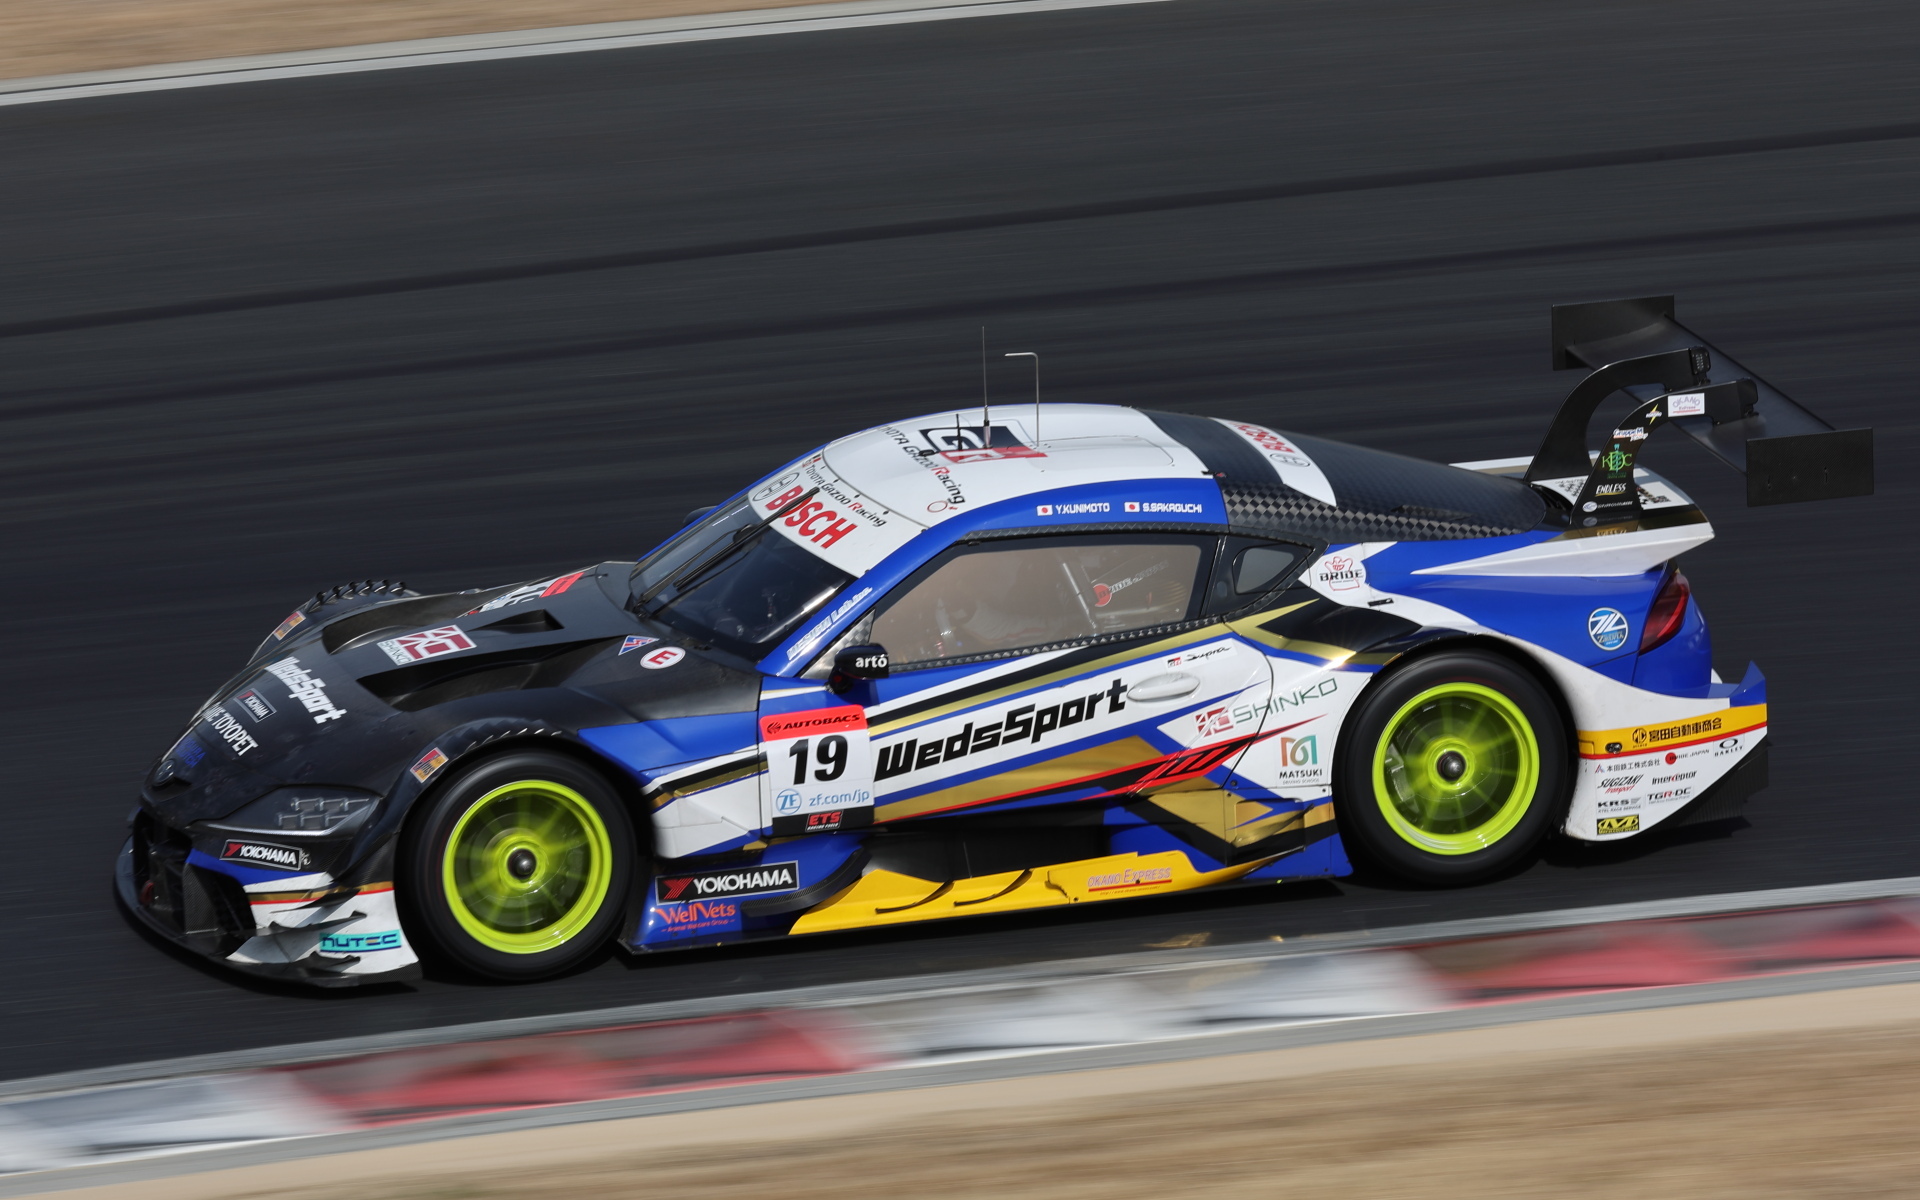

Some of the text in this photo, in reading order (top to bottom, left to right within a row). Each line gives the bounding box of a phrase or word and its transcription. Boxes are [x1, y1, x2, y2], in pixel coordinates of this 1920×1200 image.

[931, 466, 966, 504] Racing
[1595, 483, 1627, 494] ENDLESS
[806, 465, 888, 527] TOYOTA GAZOO Racing
[1055, 502, 1111, 514] Y.KUNIMOTO
[1142, 502, 1203, 513] S.SAKAGUCHI
[764, 485, 858, 550] BOSCH
[1319, 569, 1364, 582] BRIDE
[646, 650, 679, 666] E
[264, 656, 347, 725] WedsSport
[1231, 677, 1339, 725] SHINKO
[782, 713, 861, 731] AUTOBACS
[873, 678, 1128, 783] WedsSport
[1648, 716, 1722, 742] 宮田自動車商会
[211, 712, 260, 757] TOYOPET
[788, 734, 849, 786] 19
[1714, 745, 1744, 758] OAKLEY
[1279, 768, 1323, 780] MATSUKI
[1597, 773, 1644, 789] SUGIZAKI
[1651, 770, 1698, 786] Interceptor
[808, 788, 870, 808] zf.com/jp
[1597, 799, 1630, 809] KRS
[808, 811, 842, 826] ETS
[238, 843, 298, 866] YOKOHAMA
[692, 868, 793, 895] YOKOHAMA
[1087, 872, 1122, 888] OKANO
[655, 901, 737, 925] WellVets
